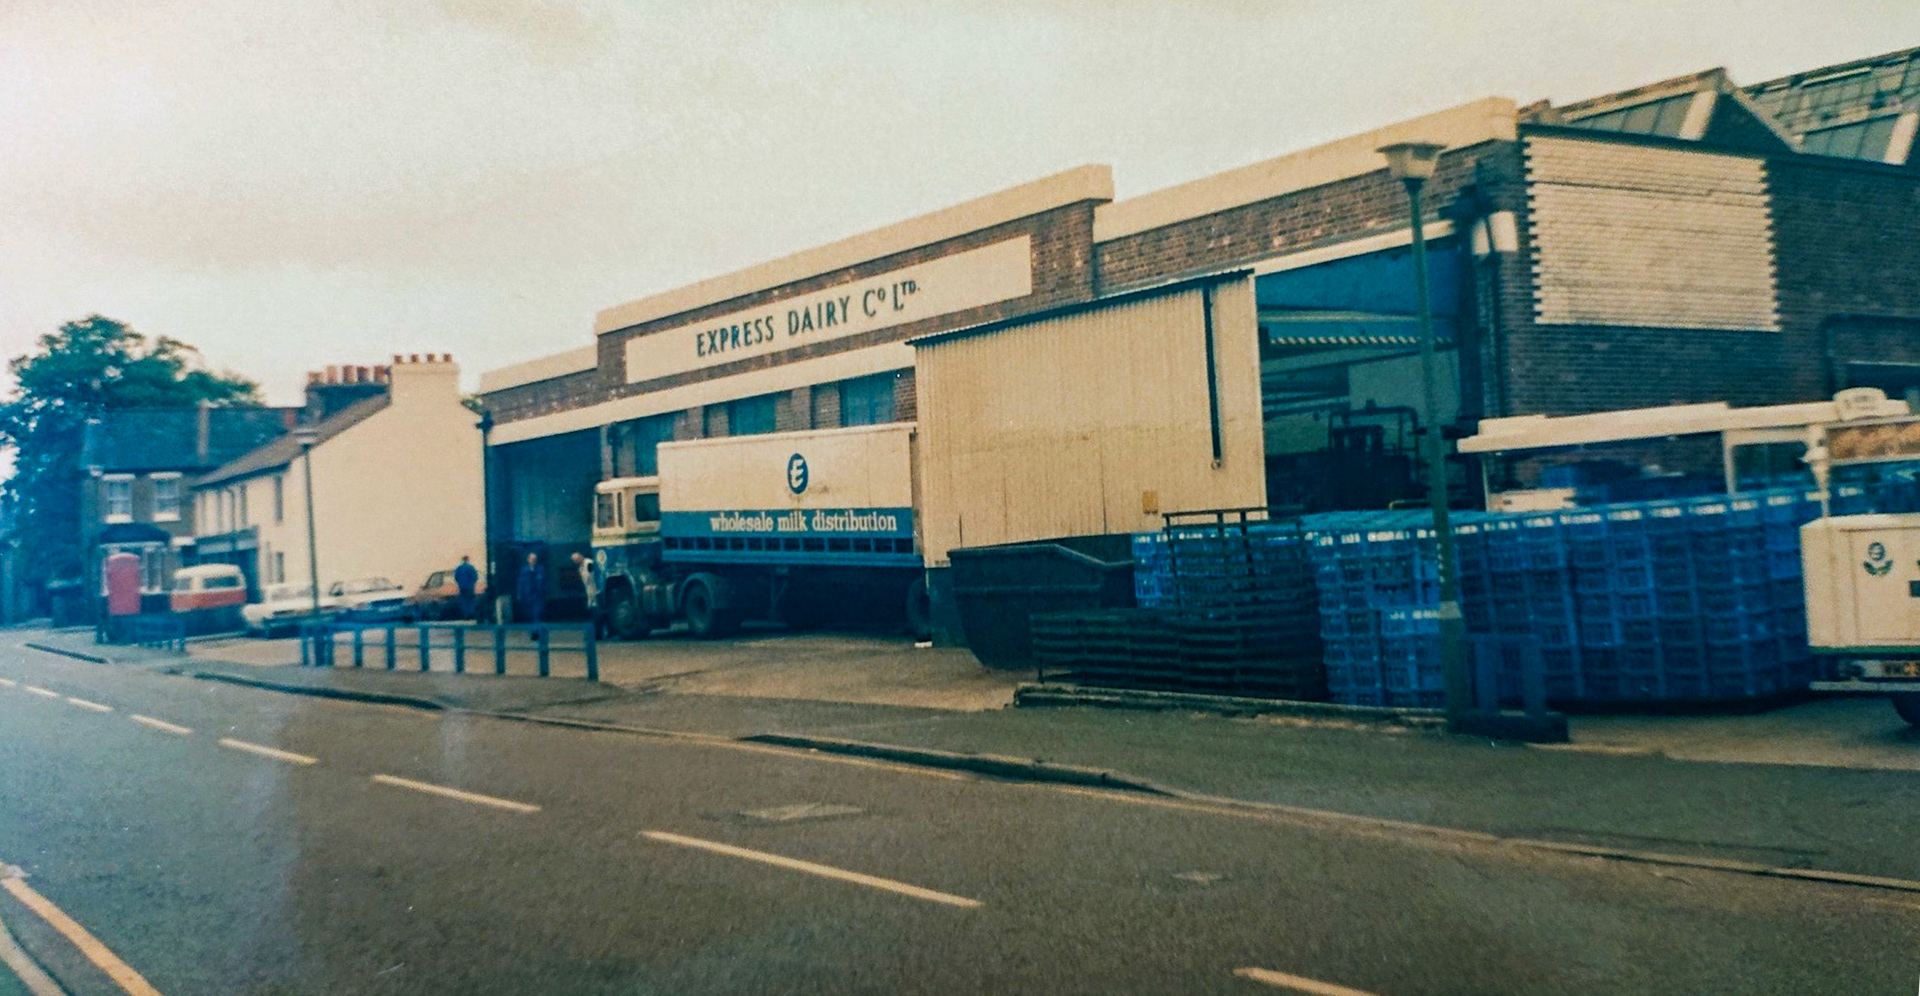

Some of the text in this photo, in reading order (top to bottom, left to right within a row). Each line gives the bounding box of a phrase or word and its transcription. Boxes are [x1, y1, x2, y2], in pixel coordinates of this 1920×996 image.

[697, 316, 774, 357] EXPRESS
[788, 296, 850, 336] DAIRY
[711, 509, 897, 532] wholesale milk distribution
